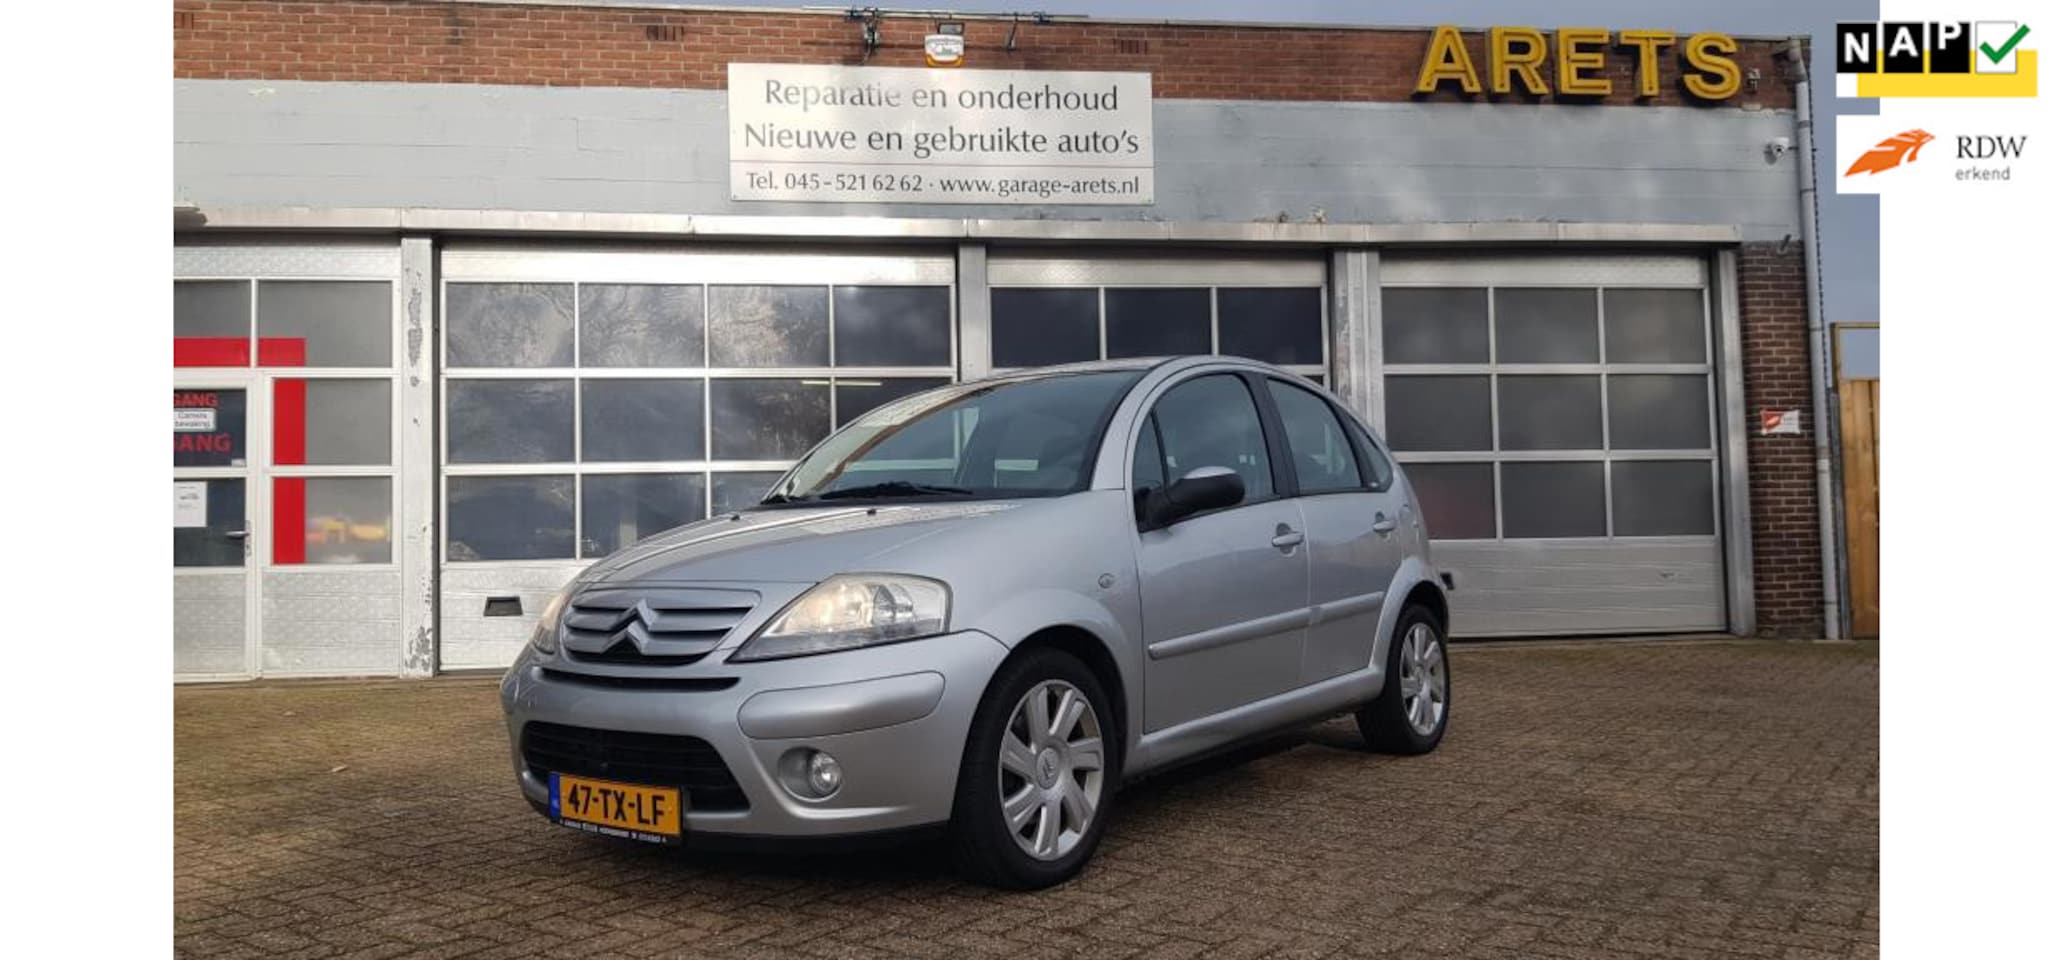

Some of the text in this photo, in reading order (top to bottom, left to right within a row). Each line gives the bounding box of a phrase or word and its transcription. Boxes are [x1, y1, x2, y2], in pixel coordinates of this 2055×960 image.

[1415, 25, 1741, 100] ARETS
[765, 79, 1118, 112] Reparatie en onderhoud
[745, 123, 1139, 159] Nieuwe en gebruikte auto's
[747, 171, 778, 190] Tel.
[174, 434, 231, 452] ANG
[568, 783, 665, 826] 47-TX-LF
